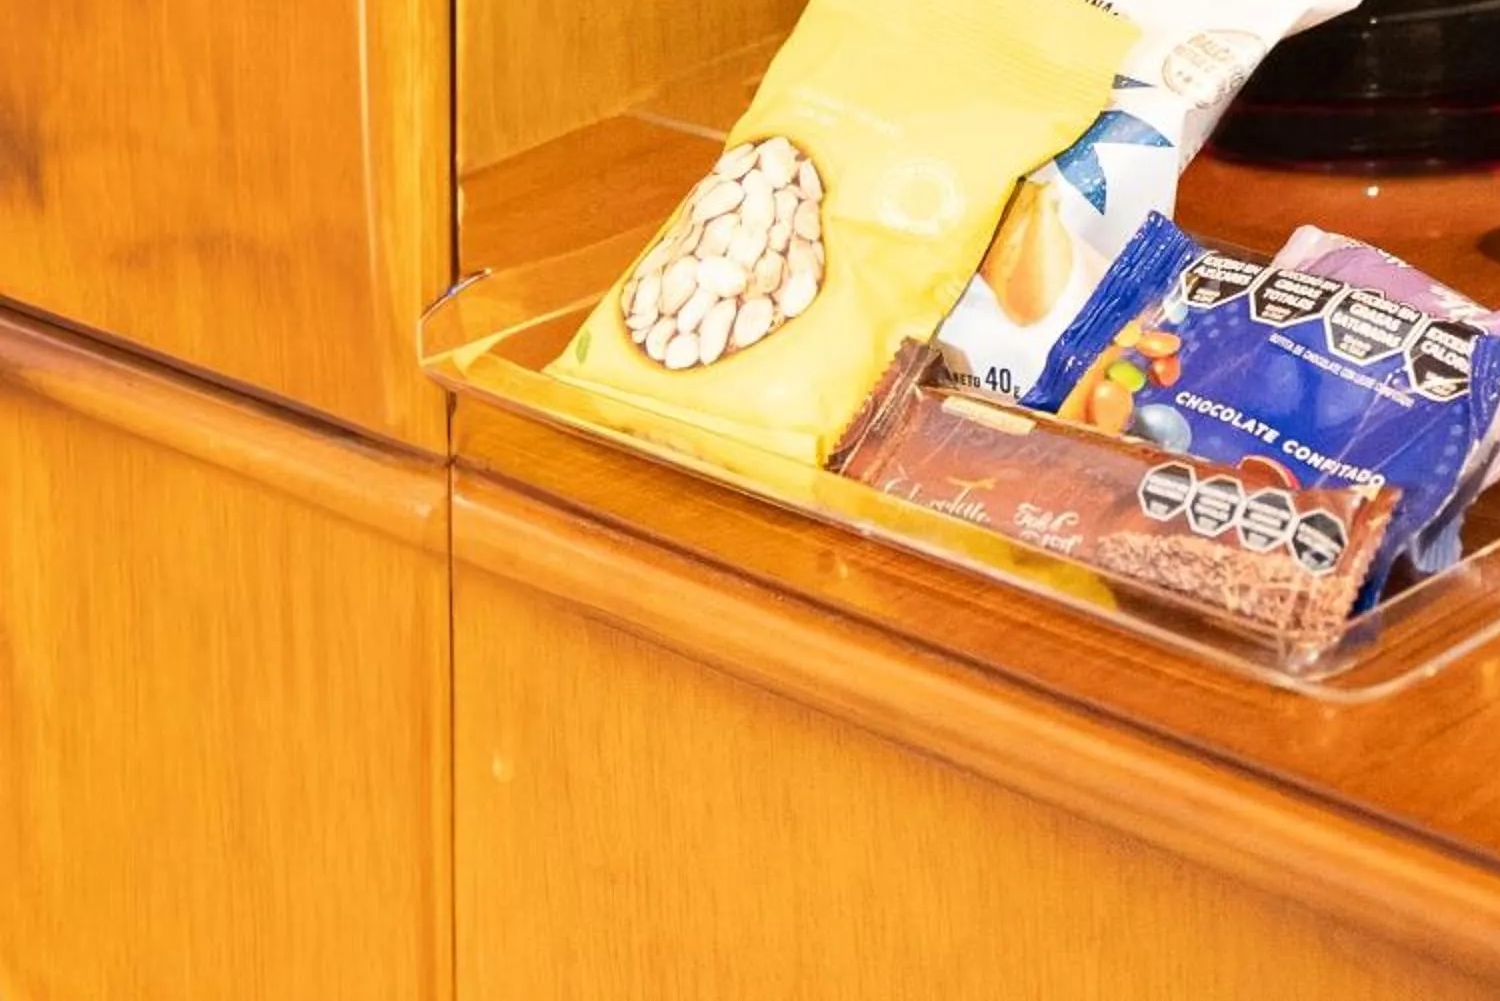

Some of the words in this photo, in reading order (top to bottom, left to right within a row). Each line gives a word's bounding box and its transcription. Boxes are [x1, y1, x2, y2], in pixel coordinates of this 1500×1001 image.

[985, 366, 1012, 394] 40
[1175, 390, 1280, 445] CHOCOLATE
[1281, 439, 1386, 488] CONFITADO
